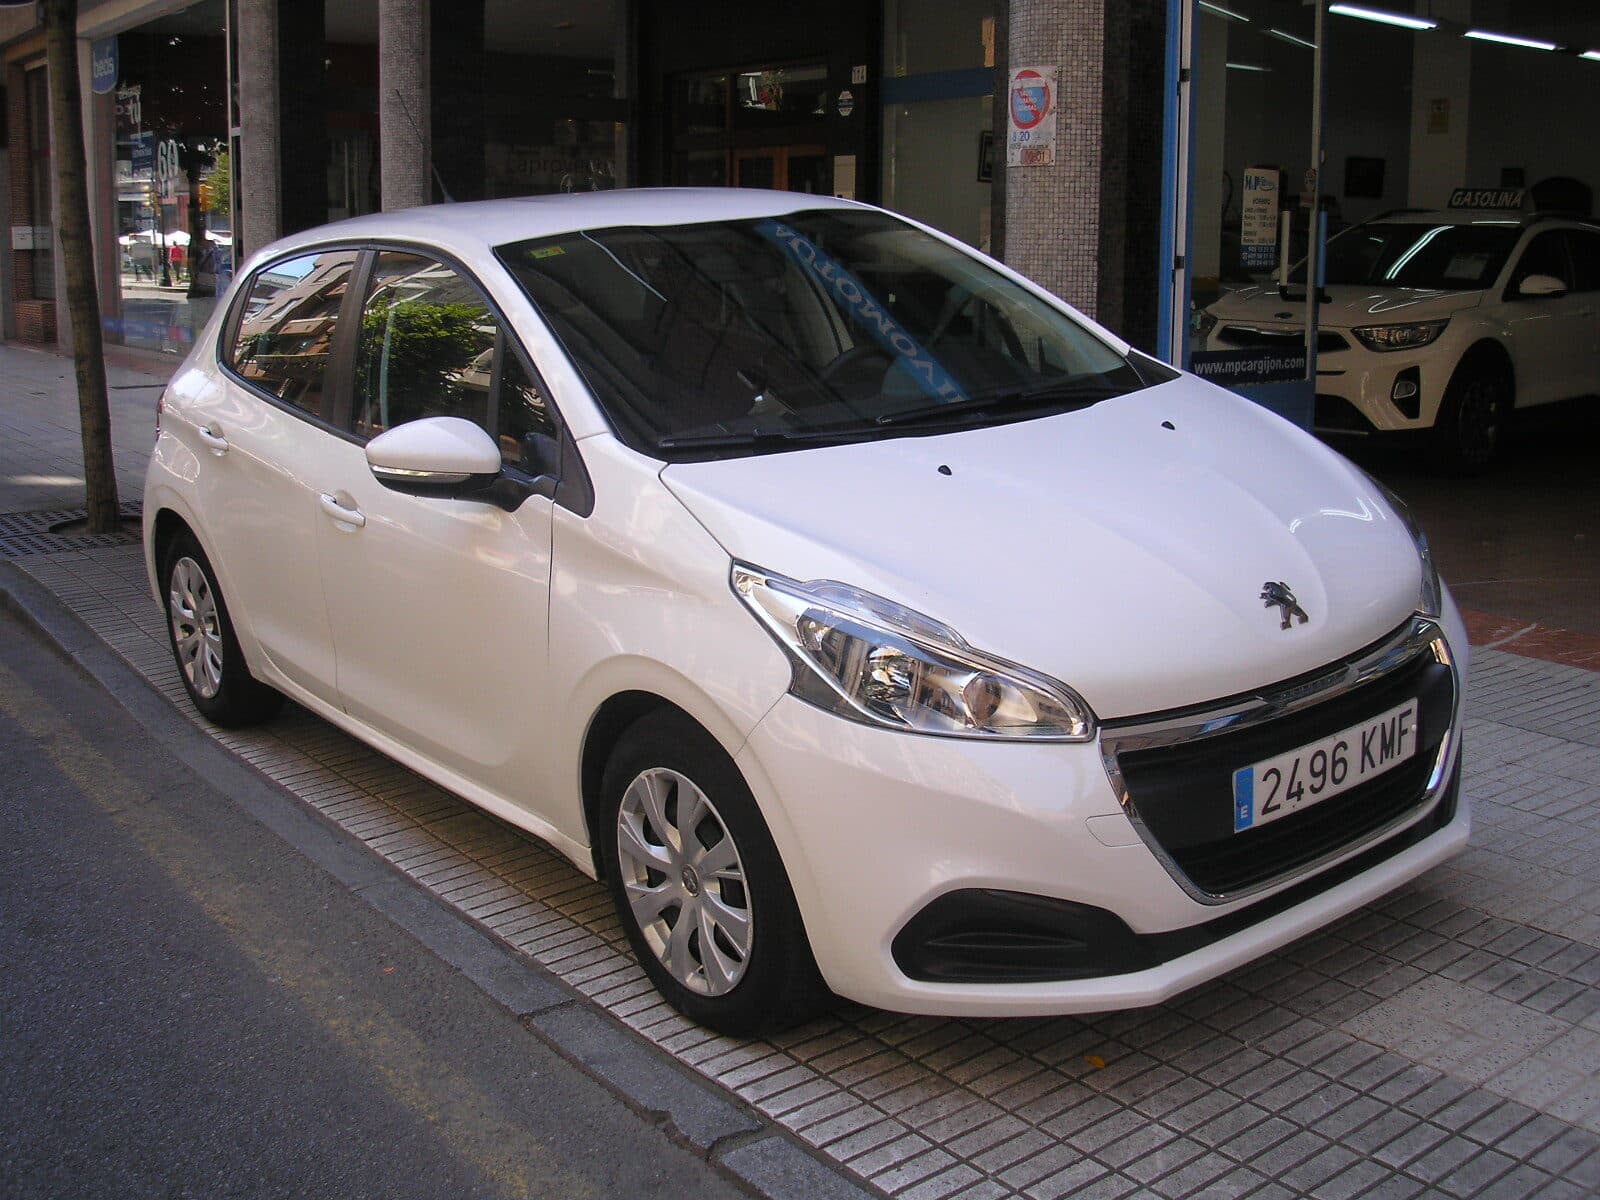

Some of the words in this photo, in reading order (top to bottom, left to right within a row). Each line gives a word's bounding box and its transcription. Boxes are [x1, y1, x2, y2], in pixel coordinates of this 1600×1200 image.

[1451, 190, 1523, 208] GASOLINA
[1194, 355, 1305, 376] www.mpcargijon.com
[1261, 740, 1348, 816] 2496
[1360, 708, 1413, 774] KMF
